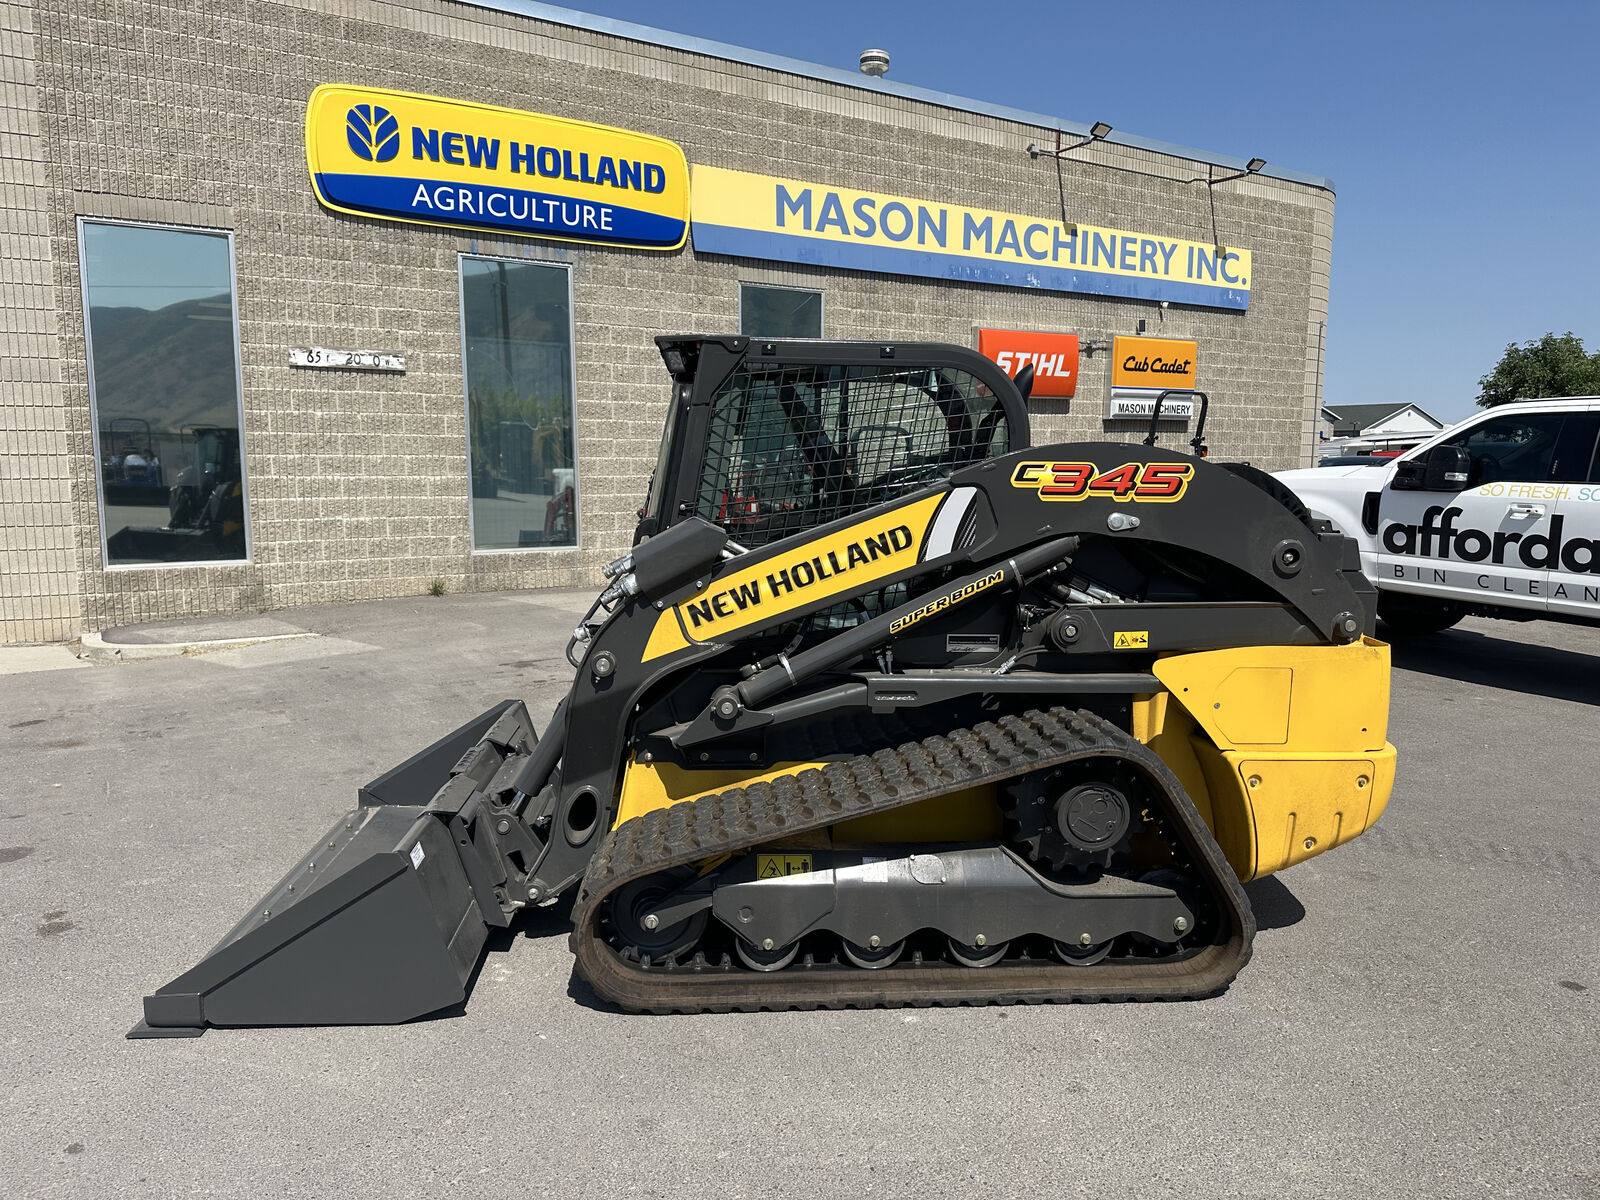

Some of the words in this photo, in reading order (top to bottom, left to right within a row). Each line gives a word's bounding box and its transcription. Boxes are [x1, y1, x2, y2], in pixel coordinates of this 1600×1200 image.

[412, 126, 500, 170] NEW
[510, 141, 666, 194] HOLLAND
[411, 183, 613, 231] AGRICULTURE
[775, 184, 948, 248] MASON
[962, 212, 1178, 275] MACHINERY
[1187, 246, 1247, 285] INC.
[996, 350, 1071, 377] STIHL
[1123, 355, 1149, 373] Cub
[1150, 357, 1191, 374] Cadet
[1118, 403, 1146, 414] MASON
[1148, 403, 1191, 414] MCHINERY
[1011, 462, 1195, 502] C345
[1480, 483, 1504, 497] SO
[1507, 485, 1571, 500] FRESH.
[1383, 505, 1600, 574] afforda
[686, 579, 760, 628] NEW
[765, 524, 914, 597] HOLLAND
[1394, 565, 1446, 583] BIN
[1477, 574, 1599, 602] CLEAN
[889, 596, 950, 634] SUPER
[951, 569, 1004, 604] BOOM
